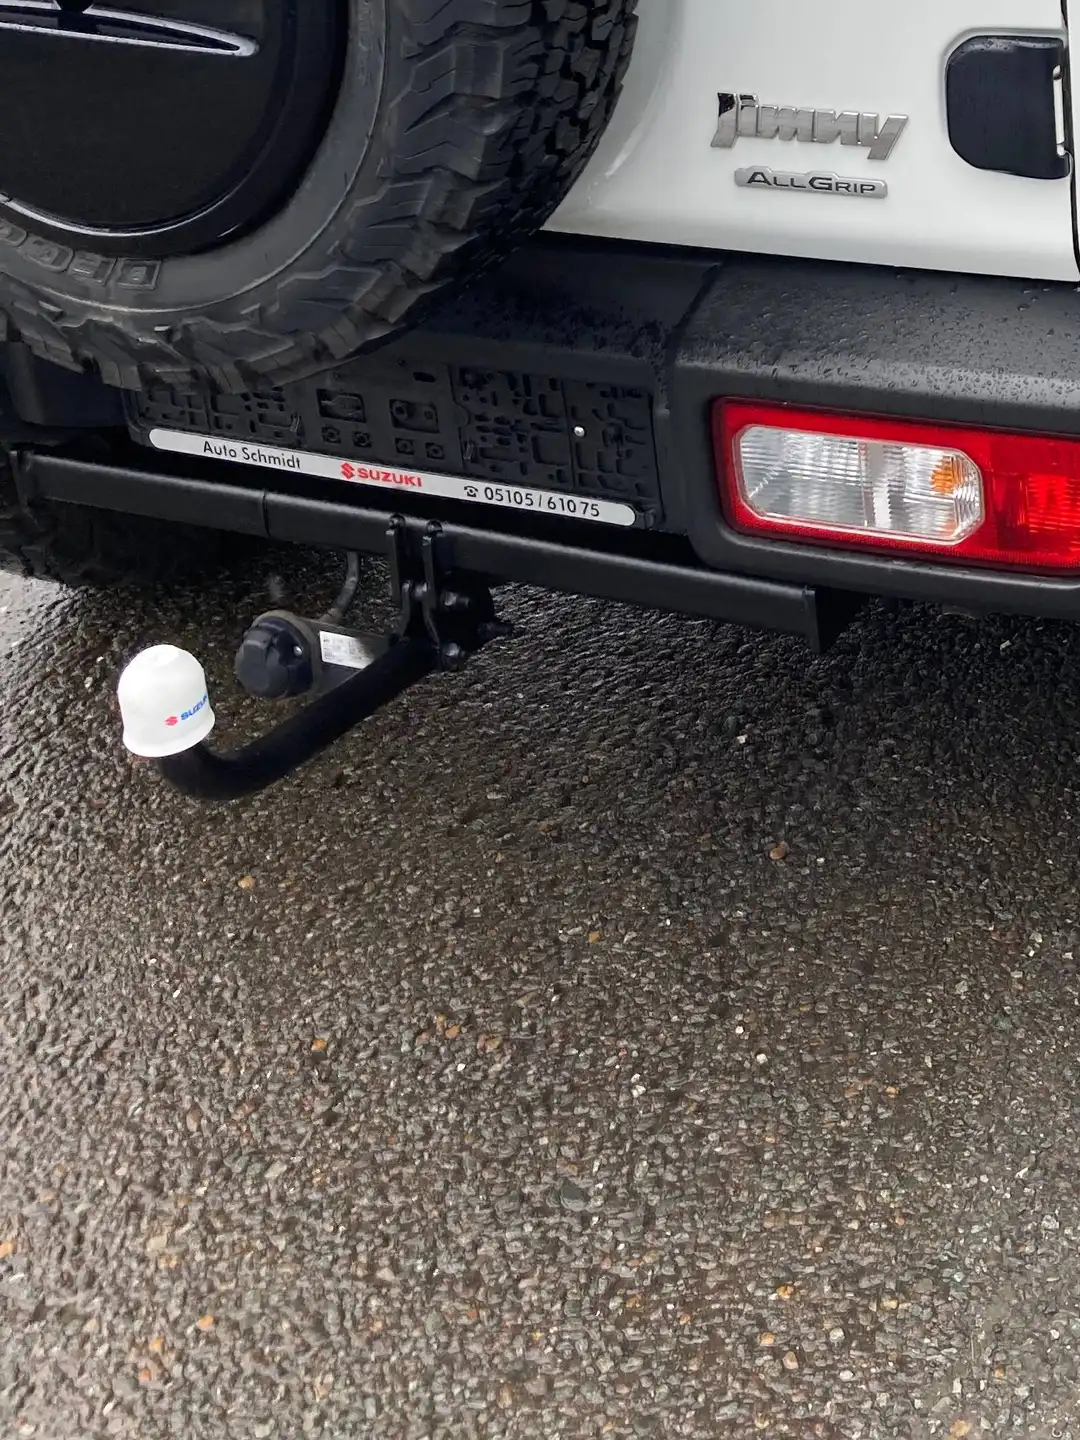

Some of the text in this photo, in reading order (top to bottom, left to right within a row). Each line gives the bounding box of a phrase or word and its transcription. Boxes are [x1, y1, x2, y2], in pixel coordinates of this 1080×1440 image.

[710, 92, 909, 160] Jimny
[203, 440, 237, 458] Auto
[242, 446, 301, 469] Schmidt
[357, 467, 422, 488] SUZUKI
